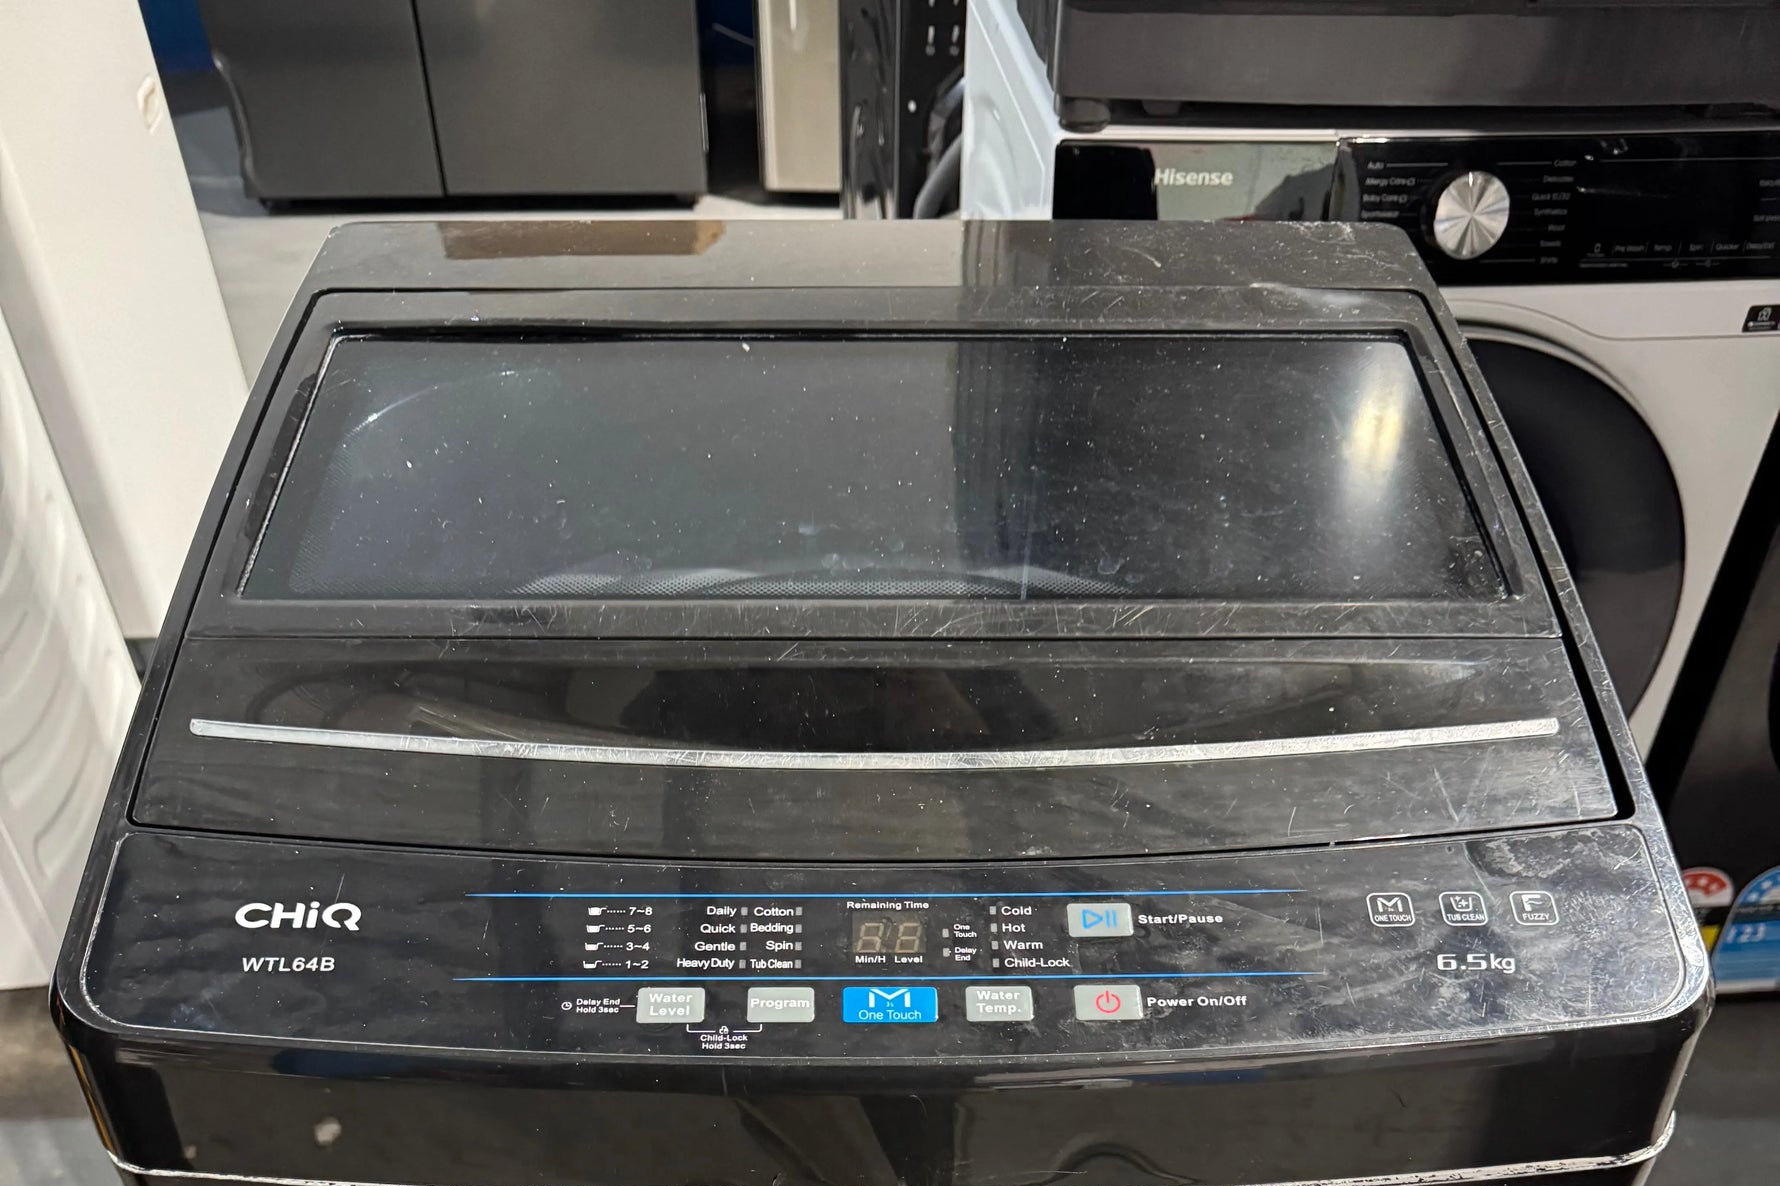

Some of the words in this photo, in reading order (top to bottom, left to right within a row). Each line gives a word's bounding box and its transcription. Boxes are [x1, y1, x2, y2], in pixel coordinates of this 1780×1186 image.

[1154, 168, 1233, 186] Hisense
[629, 906, 652, 916] 7~8
[706, 905, 737, 918] Daily
[754, 906, 794, 917] Cotton
[846, 900, 904, 912] Remaining
[906, 900, 929, 909] Time
[1001, 905, 1032, 915] Cold
[235, 901, 361, 932] CHiQ
[1138, 912, 1223, 926] Start/Pause
[627, 924, 652, 934] 5~6
[701, 923, 736, 934] Quick
[750, 922, 794, 933] Bedding
[1002, 923, 1025, 932] Hot
[625, 941, 650, 951] 3~4
[694, 941, 736, 951] Gentle
[765, 940, 794, 952] Spin
[1004, 940, 1043, 950] Warm
[954, 947, 977, 955] Delay
[625, 959, 649, 969] 1~2
[677, 958, 709, 970] Heavy
[710, 958, 735, 970] Duty
[750, 959, 767, 968] Tub
[768, 959, 794, 969] Clean
[855, 955, 885, 963] Min/H
[1004, 958, 1070, 968] Child-Lock
[1436, 953, 1515, 974] 6.5kg
[241, 957, 335, 973] WTL64B
[648, 992, 693, 1003] Water
[976, 989, 1021, 1000] Water
[576, 998, 601, 1007] Delay
[603, 998, 620, 1006] End
[750, 997, 810, 1010] Program
[1147, 997, 1194, 1008] Power
[1197, 995, 1247, 1008] On/Off
[598, 1006, 619, 1014] 3sec
[649, 1005, 690, 1016] Level
[976, 1002, 1022, 1014] Temp.
[858, 1010, 884, 1019] One
[886, 1010, 921, 1019] Touch
[700, 1033, 748, 1043] Child-Lock
[701, 1042, 724, 1050] Hold
[726, 1042, 746, 1050] 3sec
